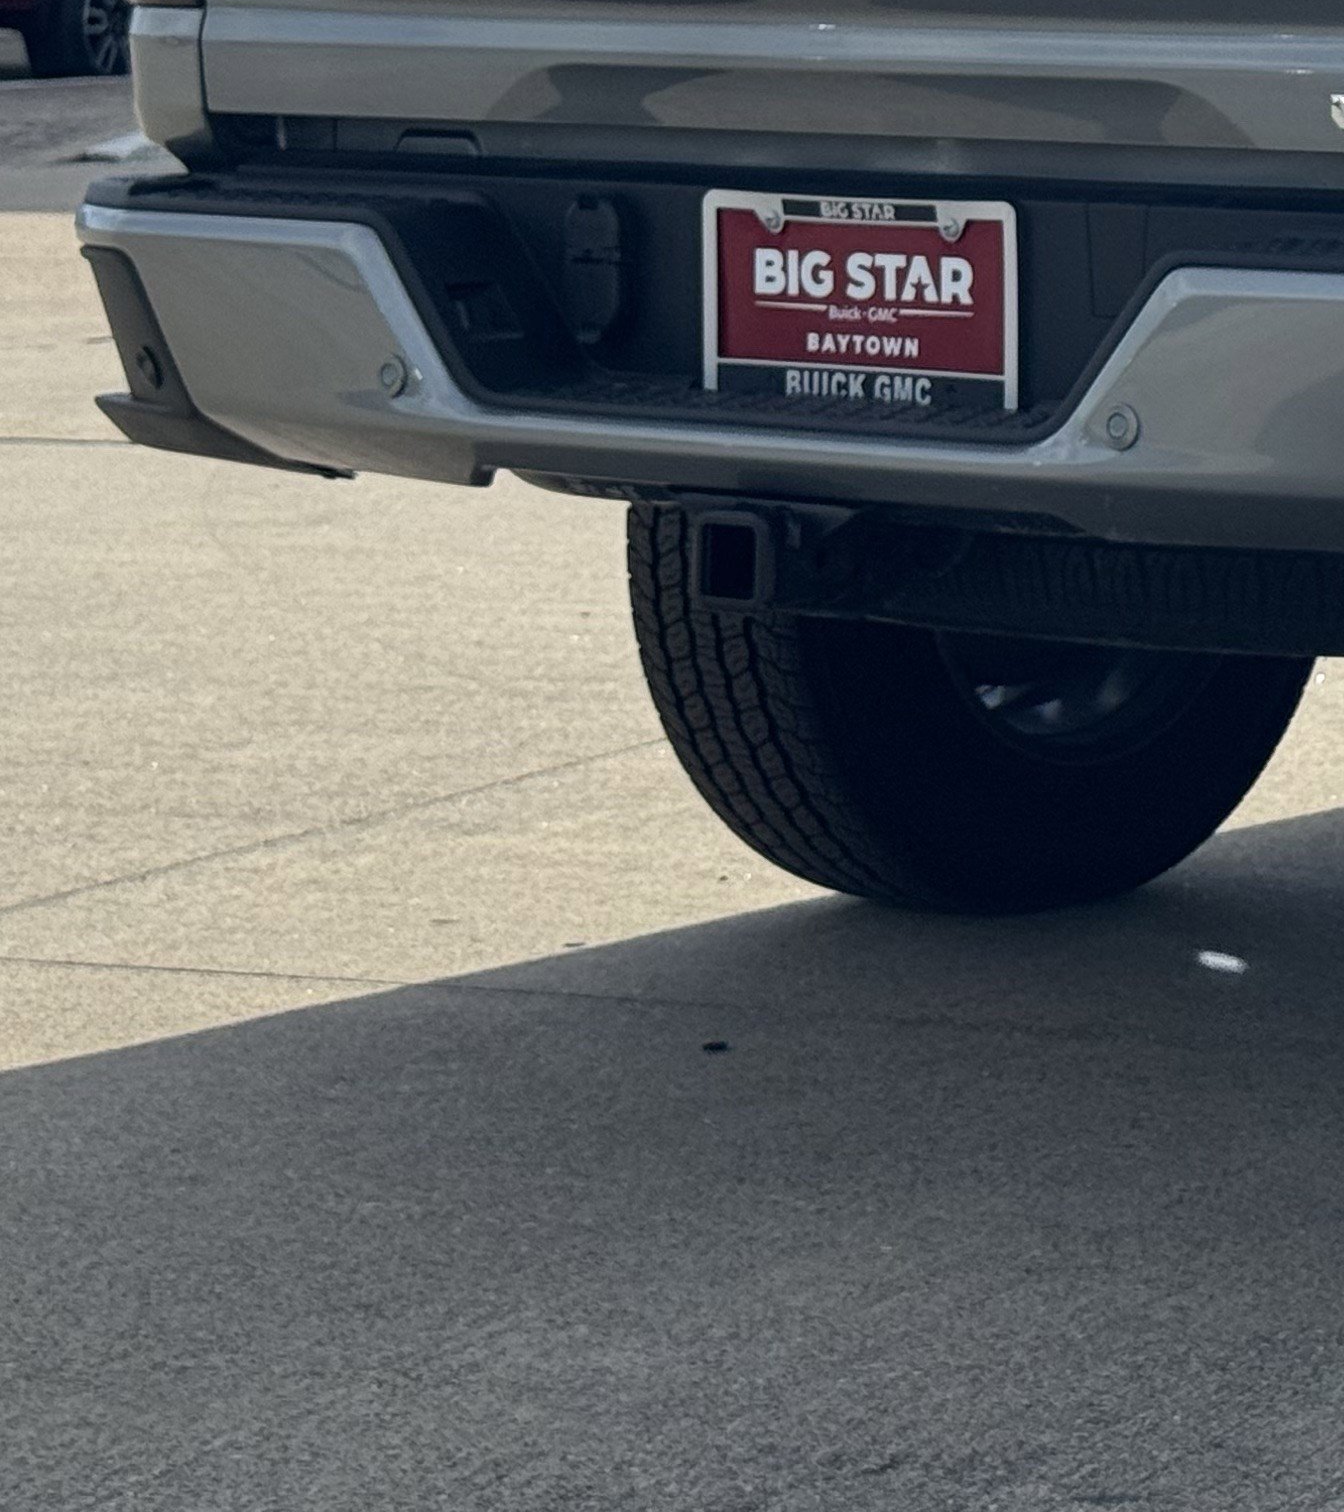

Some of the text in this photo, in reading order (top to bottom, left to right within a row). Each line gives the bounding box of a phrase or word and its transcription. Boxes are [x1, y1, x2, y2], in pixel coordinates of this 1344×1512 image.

[820, 201, 896, 221] BIG STAR
[754, 247, 975, 306] BIG STAR
[806, 332, 920, 359] BAYTOWN
[785, 369, 933, 406] BUICK GMC
